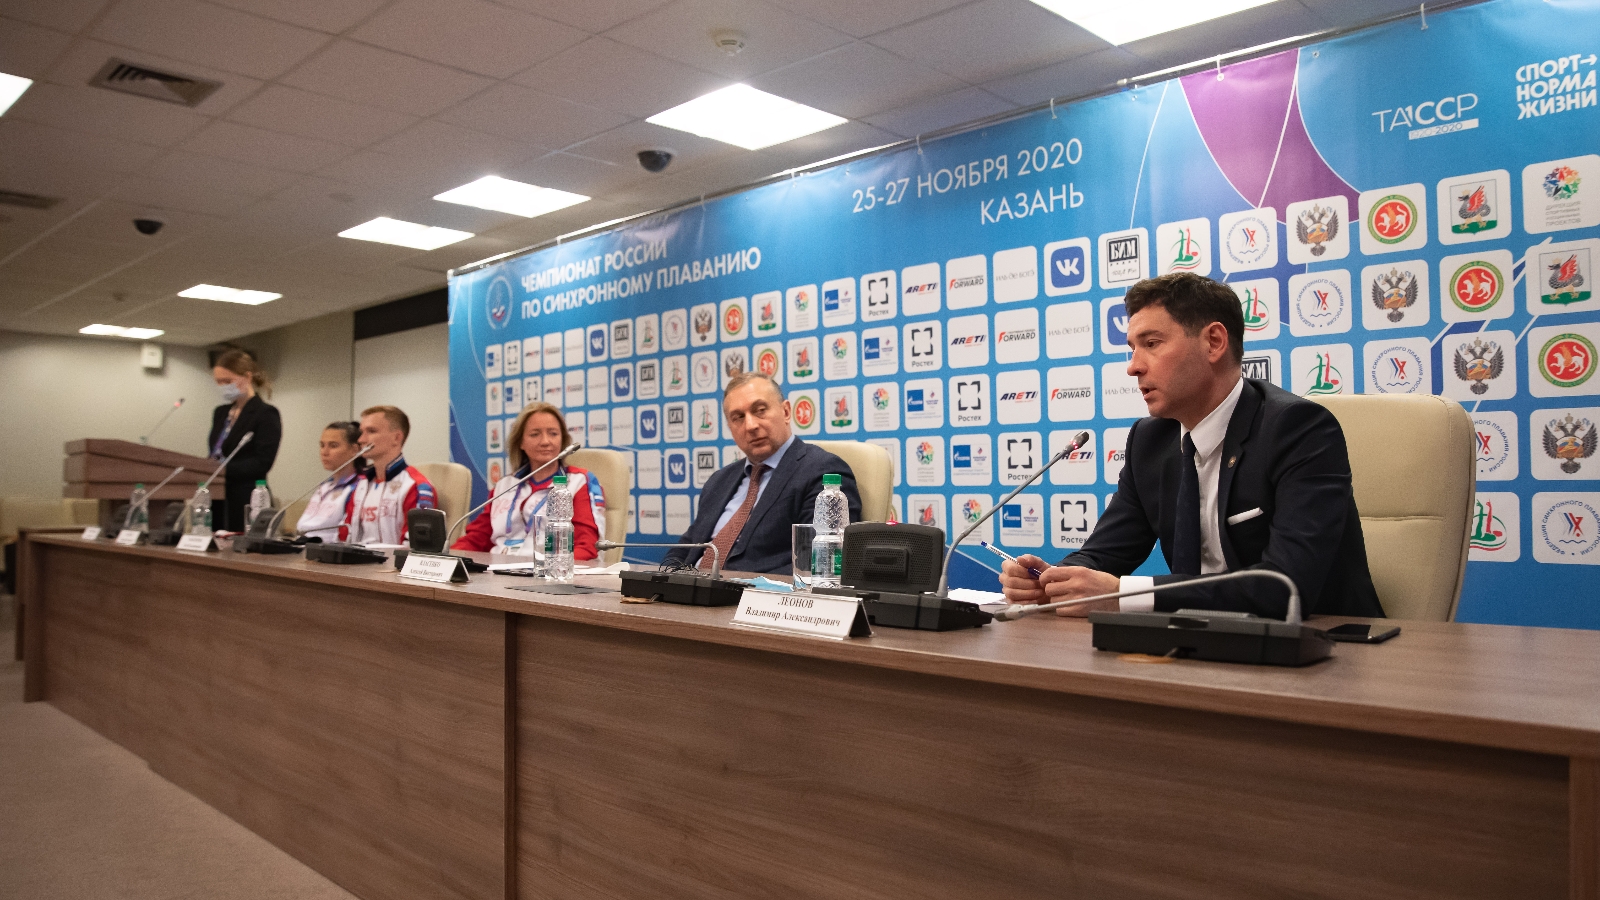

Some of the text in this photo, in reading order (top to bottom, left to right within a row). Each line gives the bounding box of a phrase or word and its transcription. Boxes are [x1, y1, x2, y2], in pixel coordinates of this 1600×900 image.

[1515, 54, 1581, 83] СПОРТ
[1516, 70, 1597, 102] НОРМА
[1517, 89, 1598, 120] ЖИЗНИ
[852, 137, 1083, 213] 25-27 НОЯБРЯ 2020
[980, 182, 1085, 225] КАЗАНЬ
[1110, 239, 1137, 260] БИМ
[521, 239, 667, 293] ЧЕМПИОНАТ РОССИИ
[1056, 257, 1080, 276] VK
[521, 246, 762, 319] ПО СИНХРОННОМУ ПЛАВАНИЮ
[949, 277, 985, 291] FORWARD
[950, 335, 985, 346] ARETI
[998, 332, 1036, 344] FORWARD
[911, 360, 934, 368] Ростех
[1000, 391, 1037, 401] ARETI
[1051, 388, 1091, 401] FORWARD
[957, 414, 982, 422] Ростех
[777, 596, 814, 609] ЛЕОНОВ
[745, 606, 841, 627] Владимир Александрович
